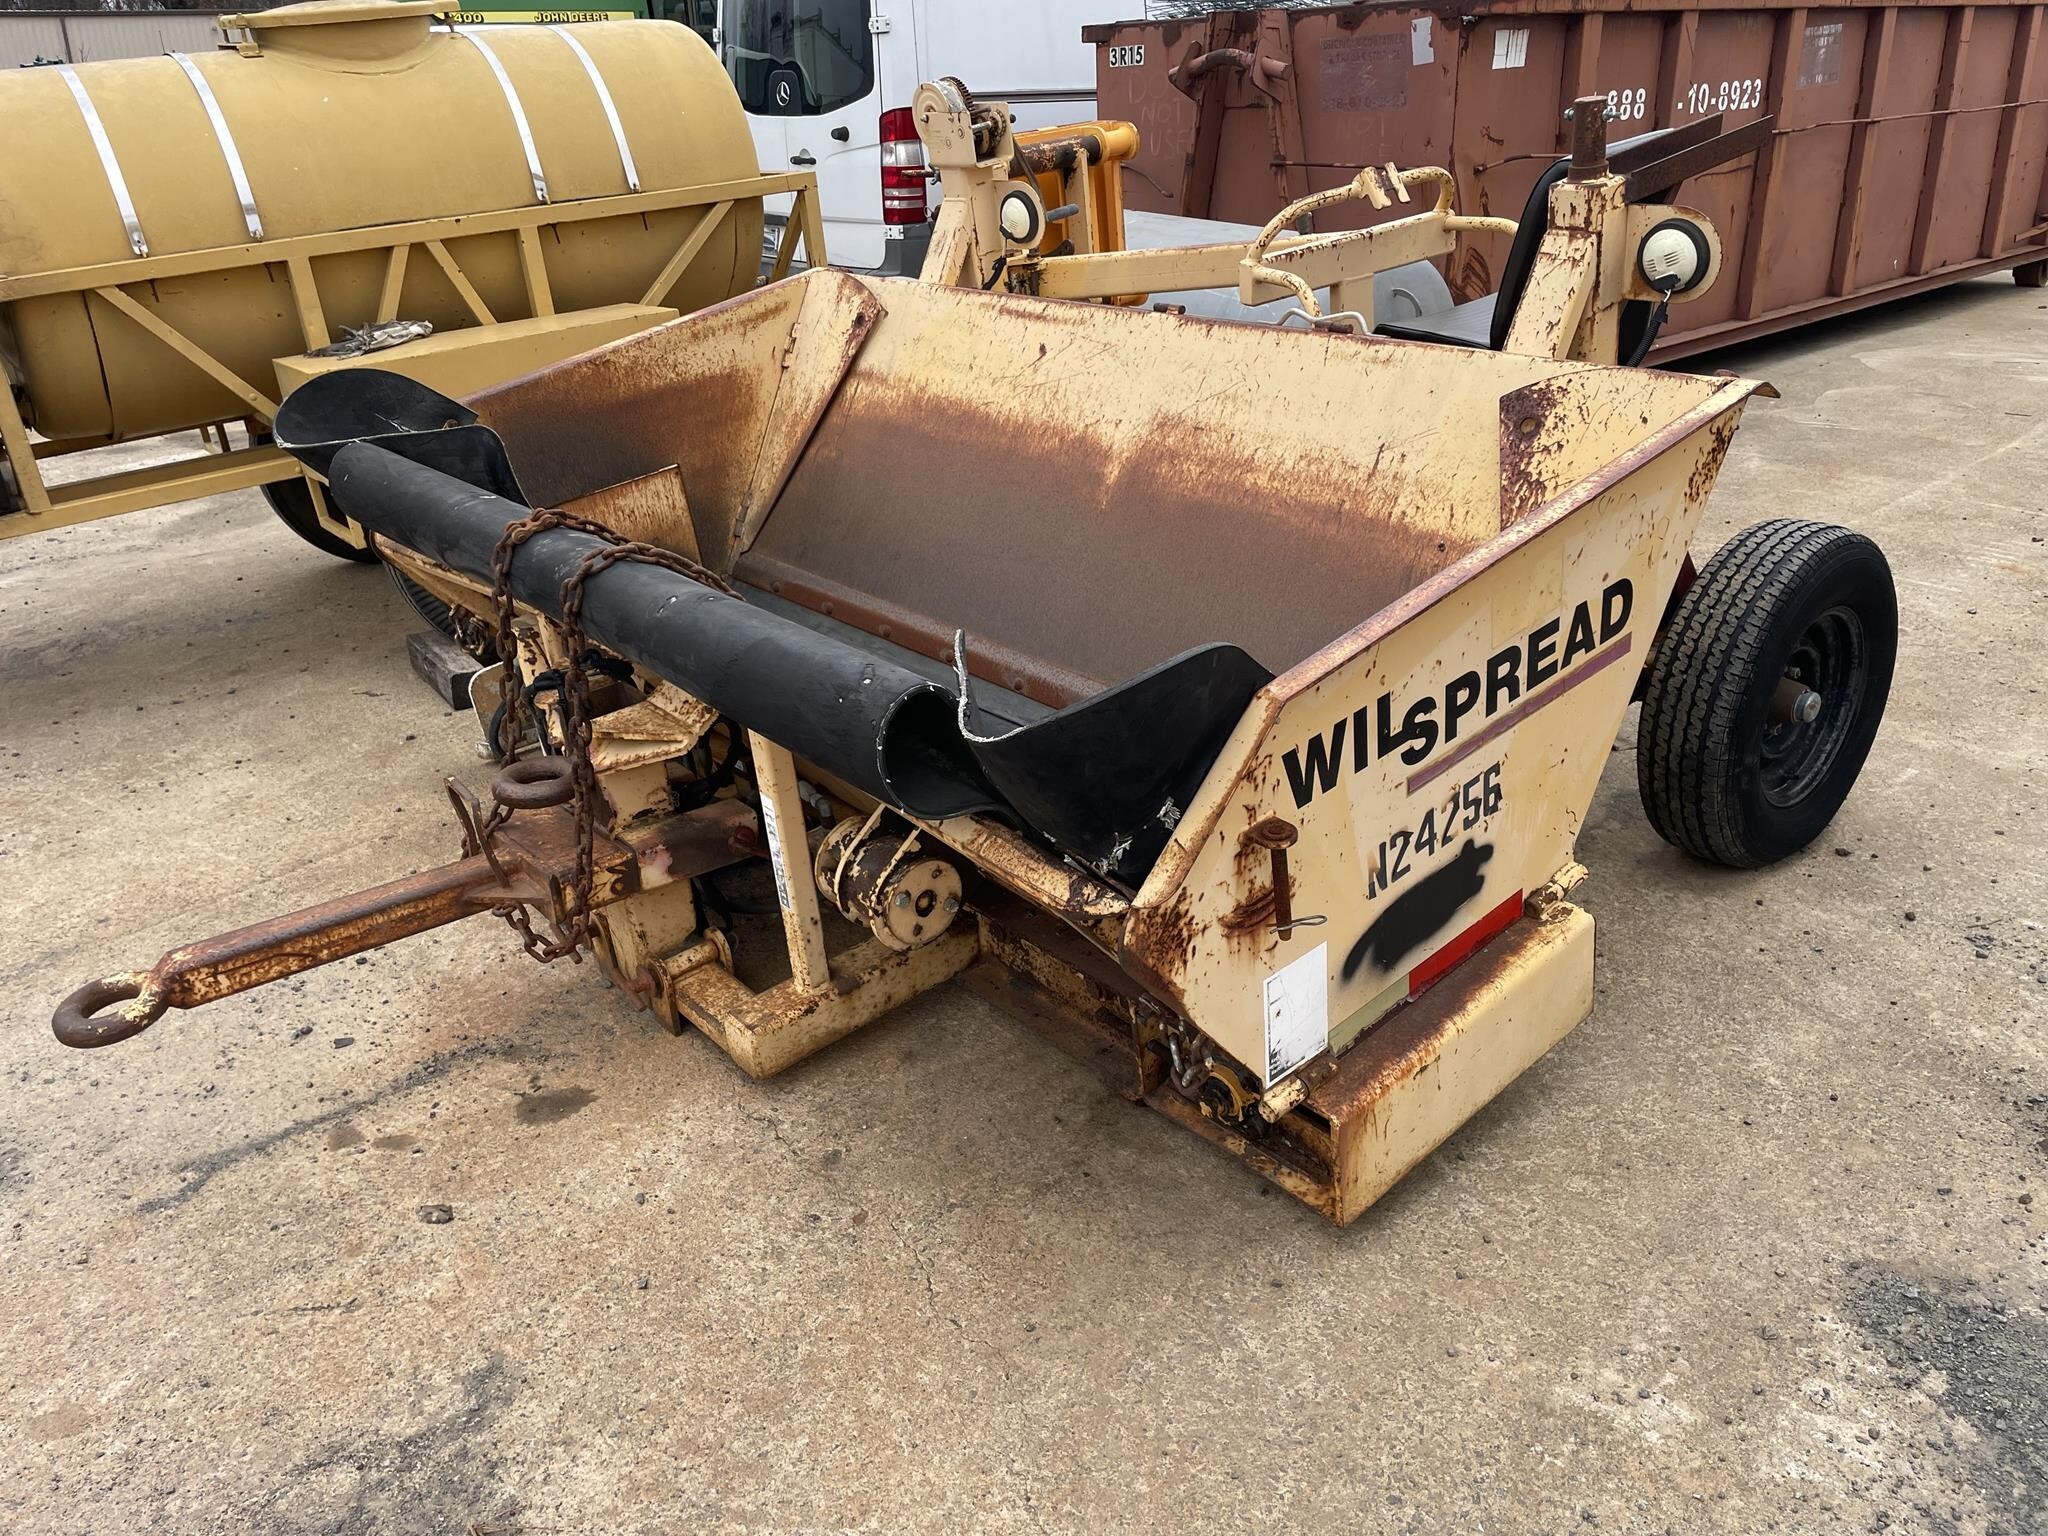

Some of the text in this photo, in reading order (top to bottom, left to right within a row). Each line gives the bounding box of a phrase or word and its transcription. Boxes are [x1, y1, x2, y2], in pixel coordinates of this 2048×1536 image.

[449, 12, 485, 24] 400
[534, 11, 609, 23] JOHN DEERE
[1109, 46, 1143, 66] 3R15
[1127, 70, 1169, 105] DO
[1140, 97, 1180, 128] NOT
[1150, 126, 1192, 159] USE
[1281, 578, 1634, 810] WILSPREAD
